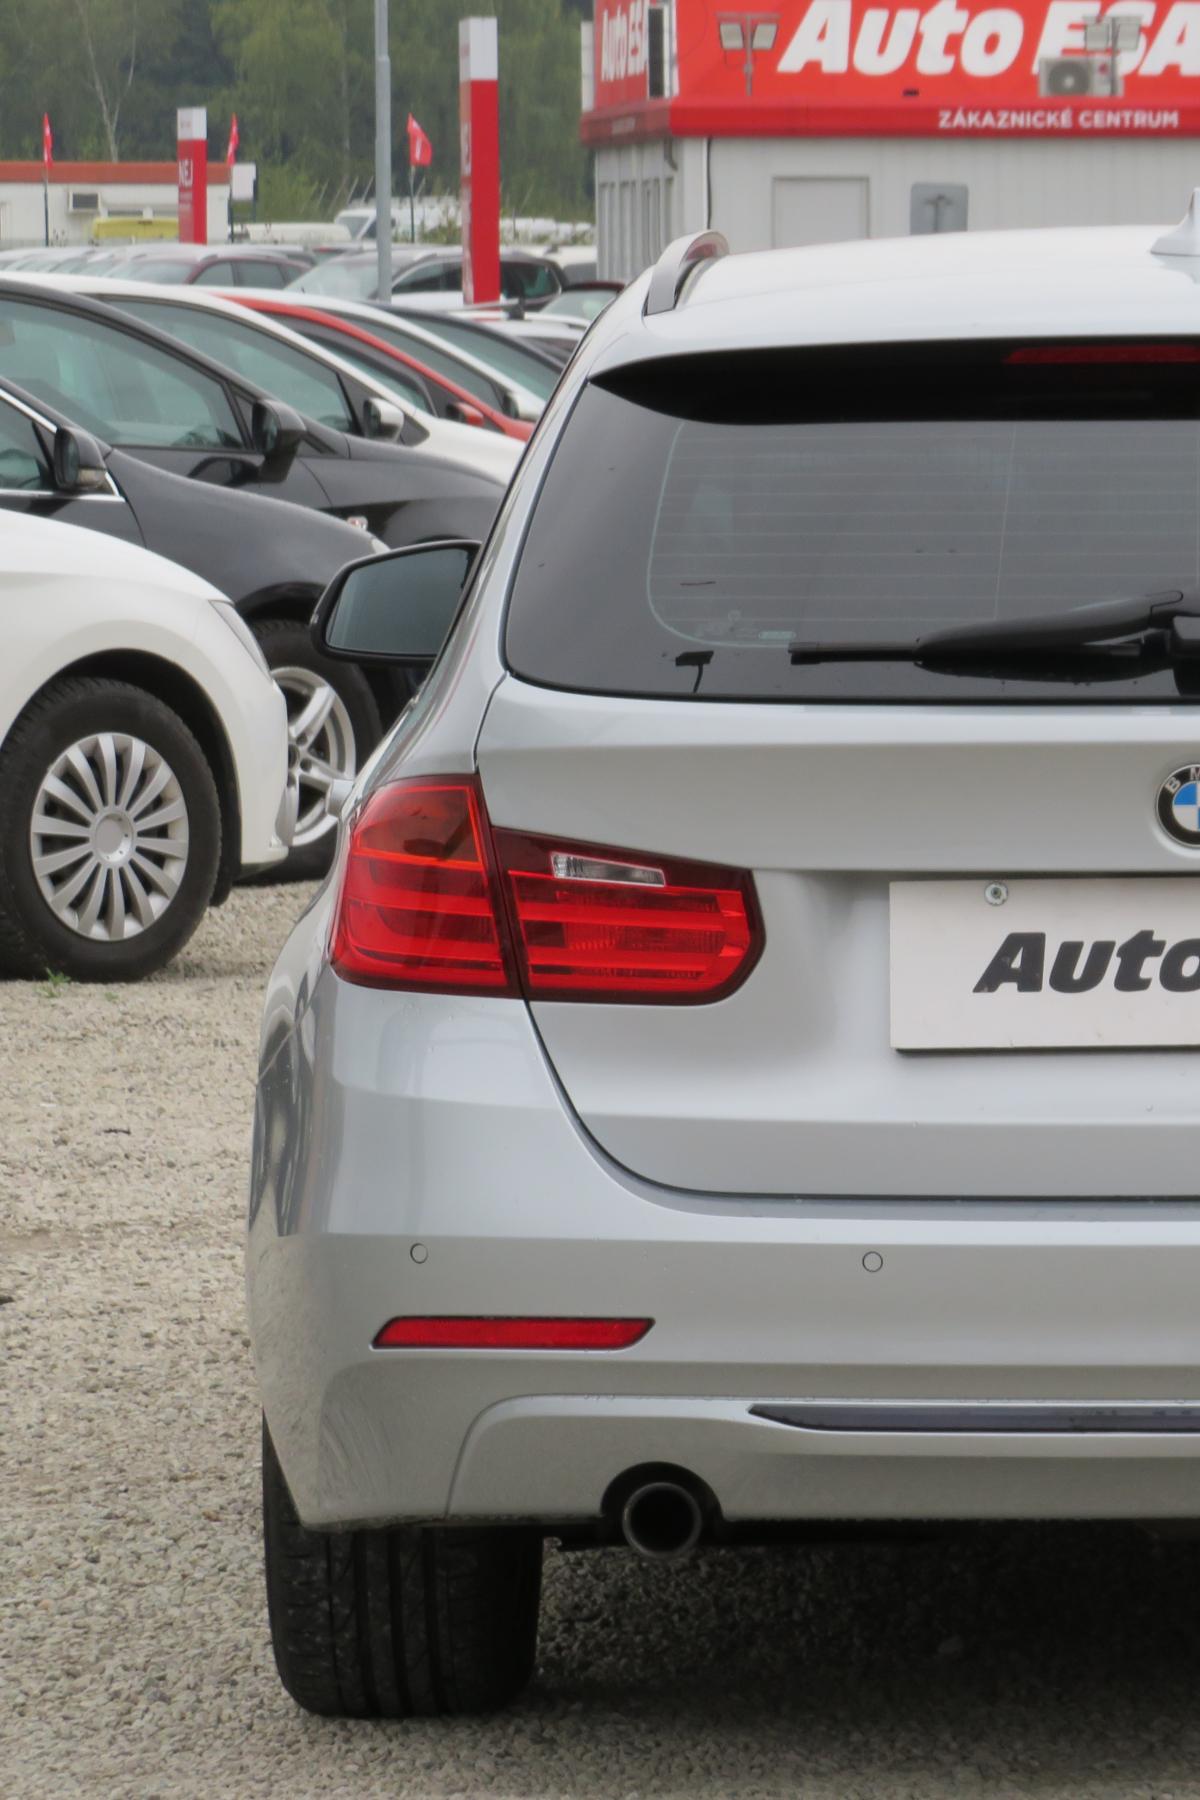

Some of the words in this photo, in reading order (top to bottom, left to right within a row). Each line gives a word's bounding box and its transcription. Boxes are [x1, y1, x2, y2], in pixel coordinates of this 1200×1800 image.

[627, 0, 649, 77] ES
[776, 0, 1024, 76] Auto
[938, 107, 1073, 129] ZÁKAZNICKÉ
[1078, 110, 1180, 129] CENTRUM
